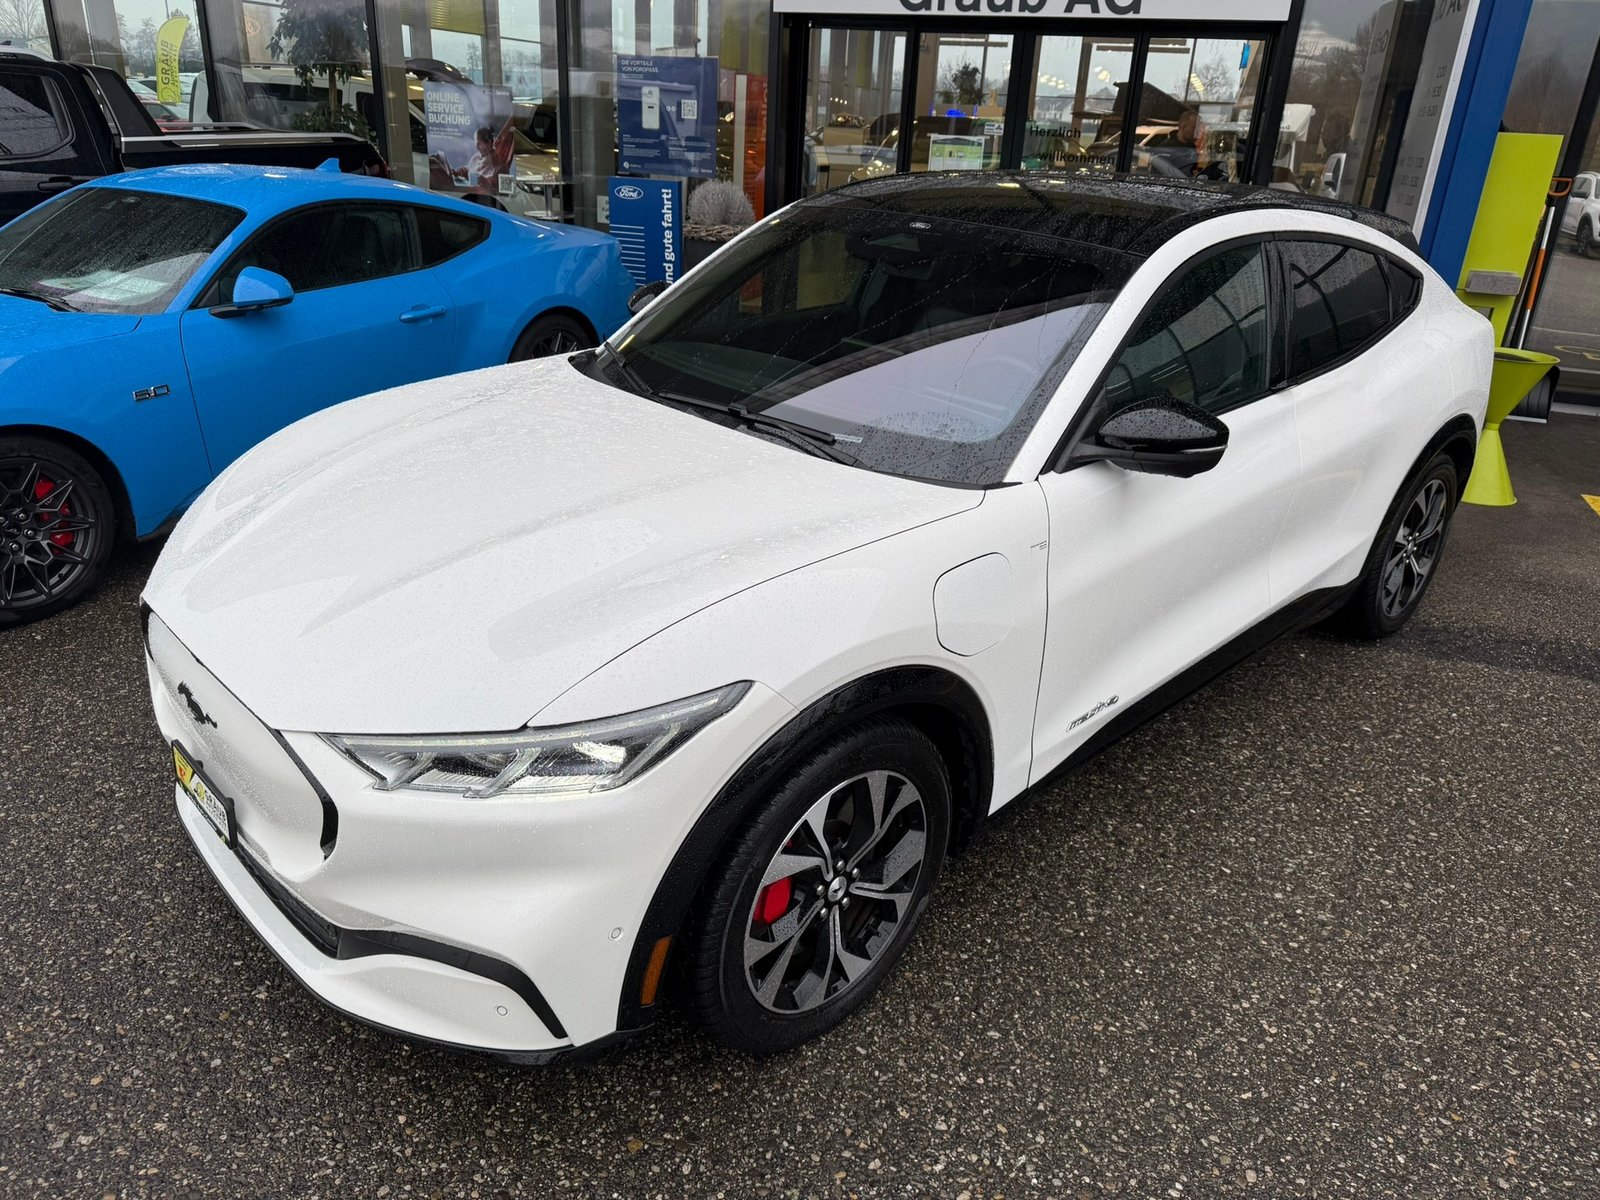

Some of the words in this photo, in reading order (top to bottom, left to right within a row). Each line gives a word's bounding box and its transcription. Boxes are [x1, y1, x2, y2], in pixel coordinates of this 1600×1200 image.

[159, 40, 170, 85] GRÄUB
[427, 91, 460, 103] ONLINE
[427, 102, 464, 114] SERVICE
[428, 113, 471, 126] BUCHUNG
[1029, 125, 1081, 138] Herzlich
[1039, 150, 1115, 164] willkommen
[618, 187, 640, 198] Ford
[661, 189, 673, 228] fahrt!
[663, 230, 676, 262] gute
